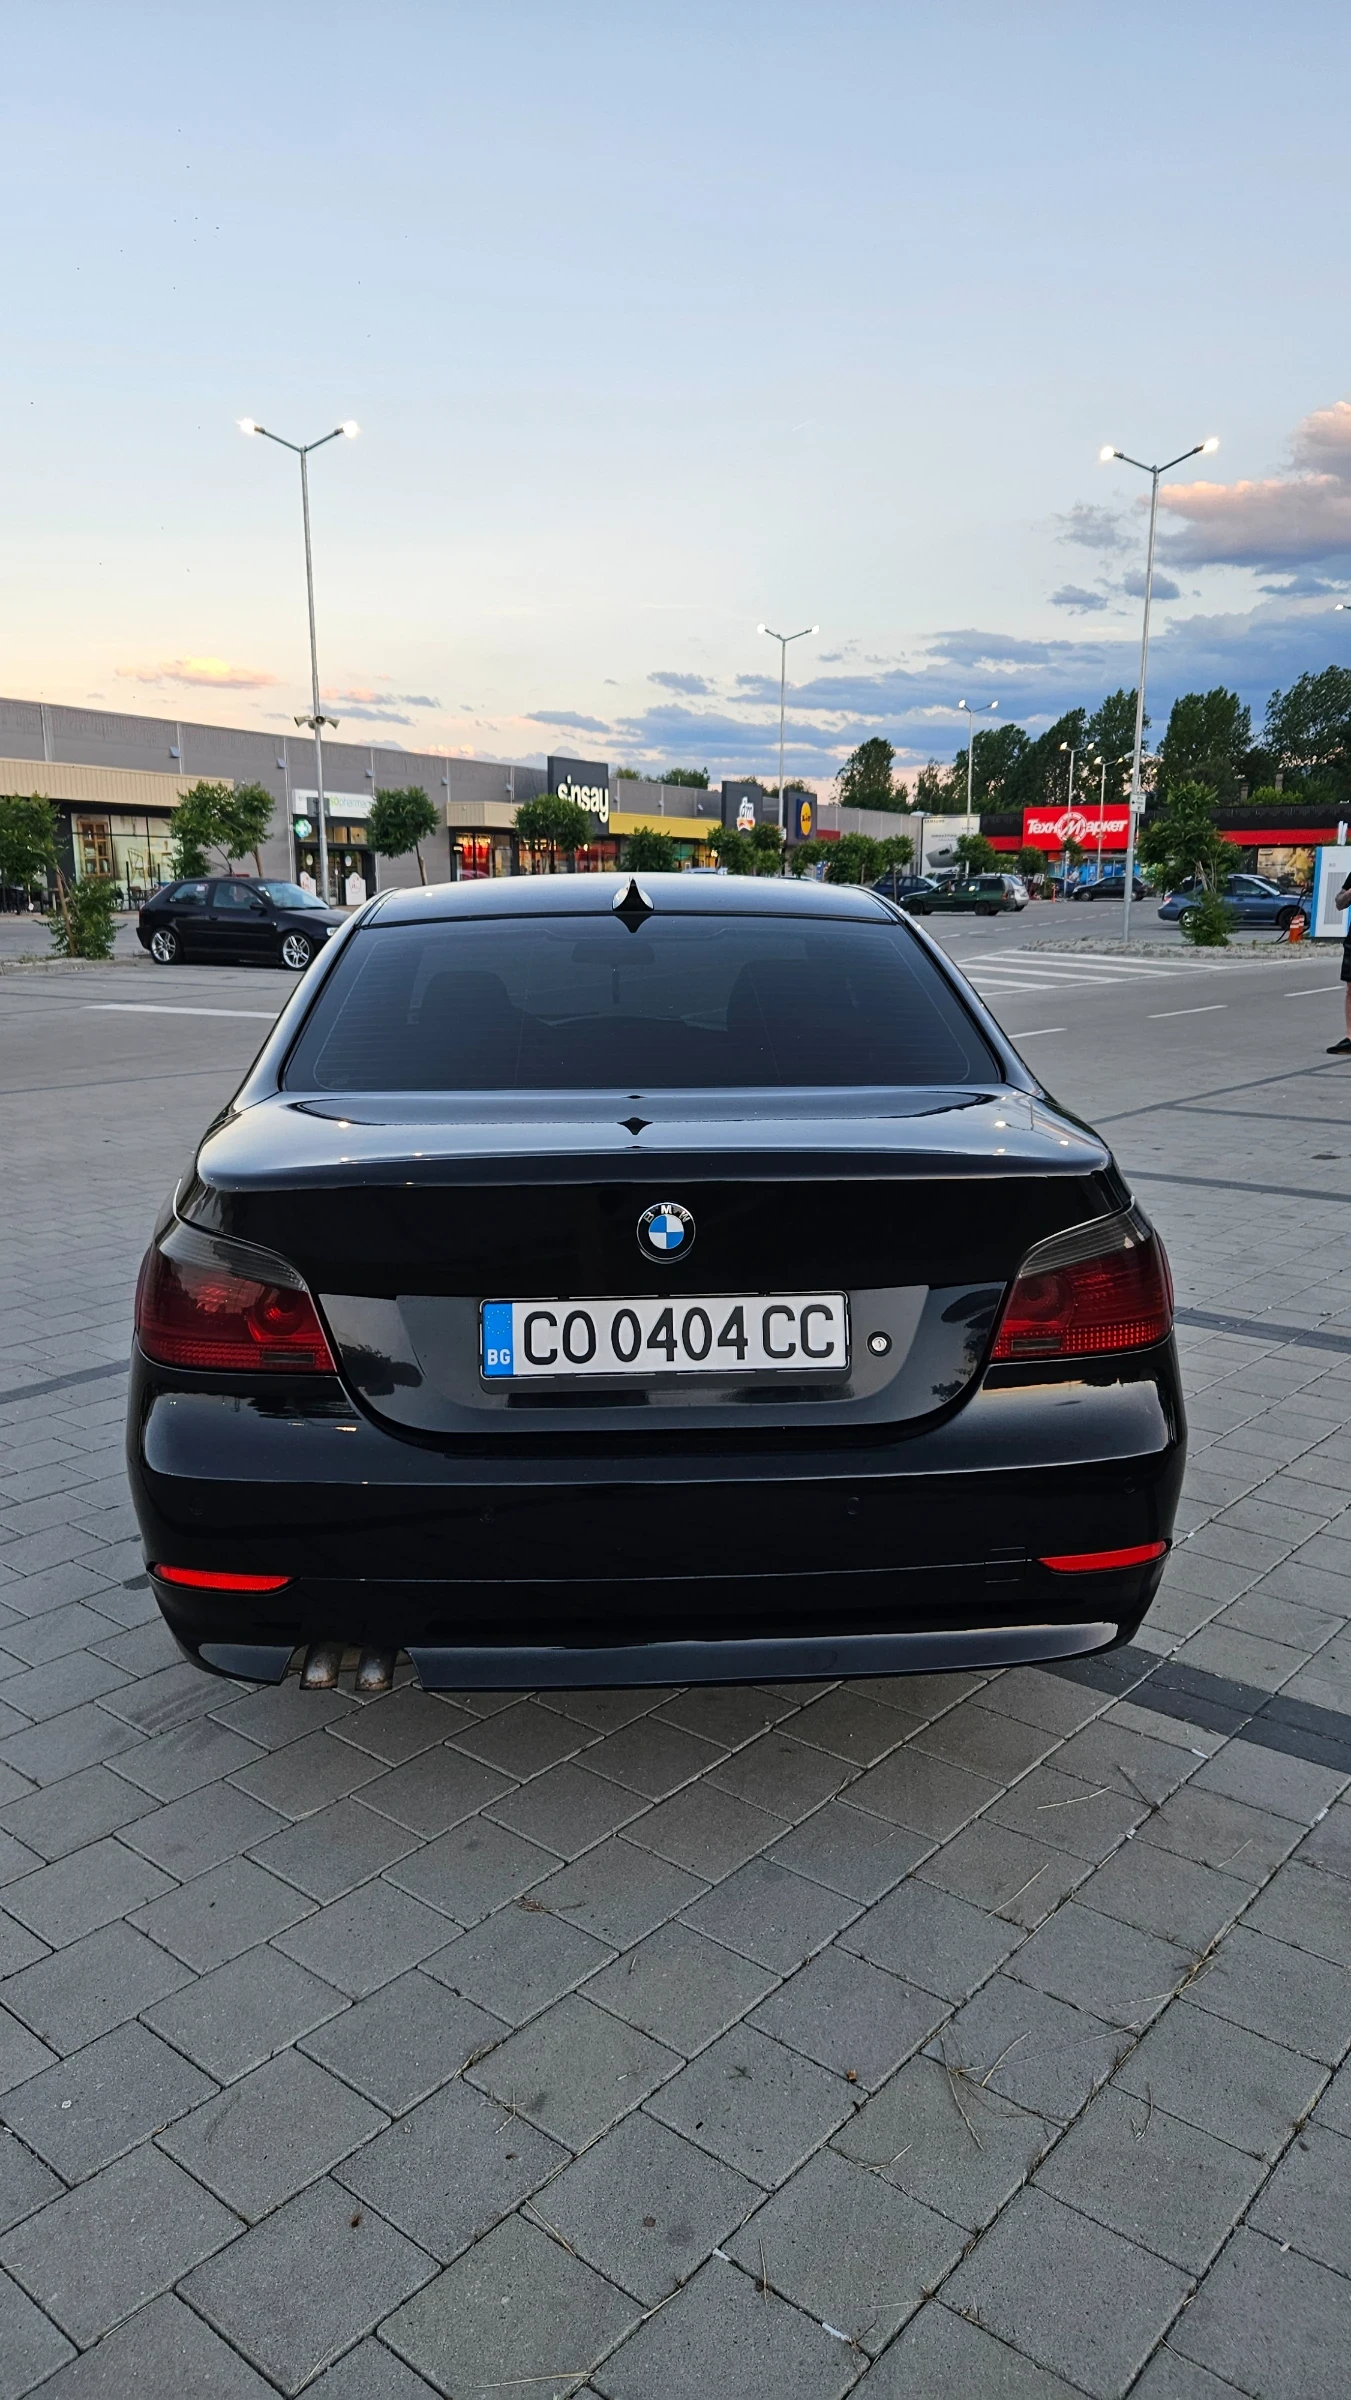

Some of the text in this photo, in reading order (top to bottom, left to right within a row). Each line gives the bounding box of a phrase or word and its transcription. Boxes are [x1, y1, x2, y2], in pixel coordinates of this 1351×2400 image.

[557, 774, 609, 823] sinsay
[643, 1204, 691, 1224] BMW
[523, 1304, 835, 1365] CO 0404 CC
[487, 1348, 511, 1366] BG
